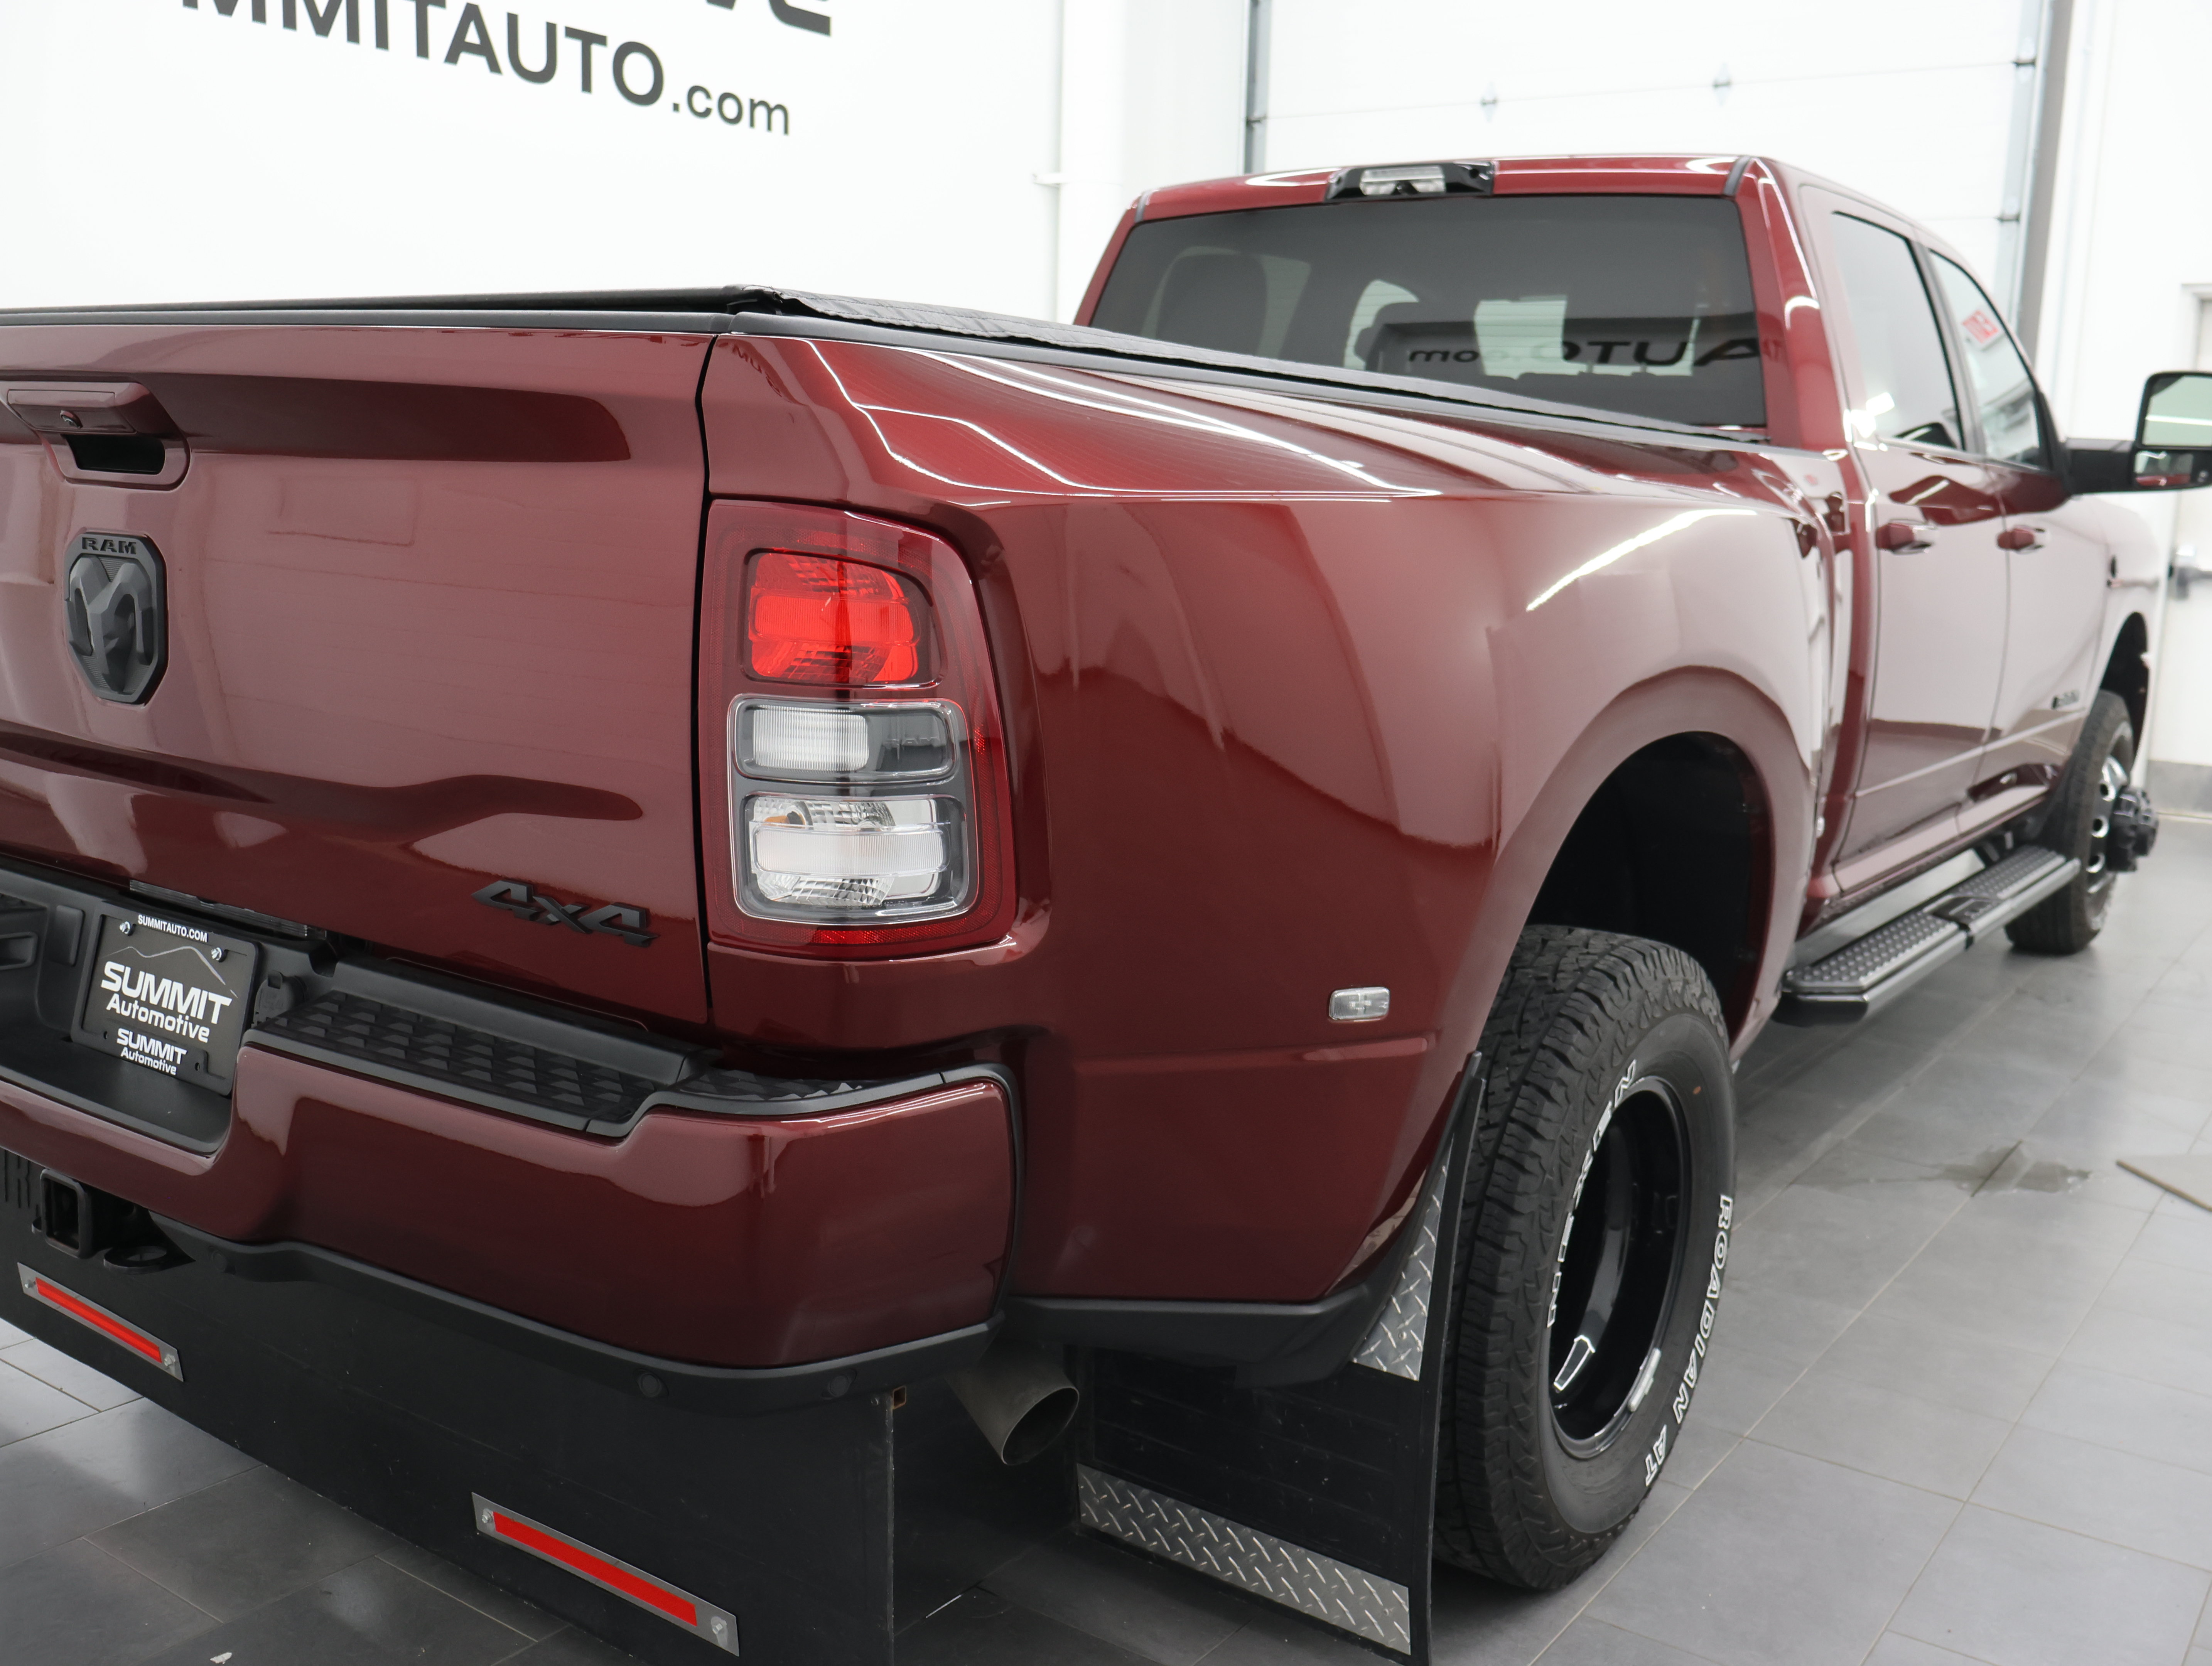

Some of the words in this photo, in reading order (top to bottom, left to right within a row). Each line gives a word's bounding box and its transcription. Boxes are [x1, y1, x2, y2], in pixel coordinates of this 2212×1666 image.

[81, 536, 137, 555] RAM
[138, 914, 208, 943] SUMMITAUTO.COM
[101, 961, 232, 1024] SUMMIT
[106, 994, 209, 1043] Automotive
[116, 1028, 187, 1064] SUMMIT
[121, 1047, 177, 1075] Automotive
[1672, 1194, 1733, 1425] ROADIAN
[1645, 1424, 1667, 1487] AT
